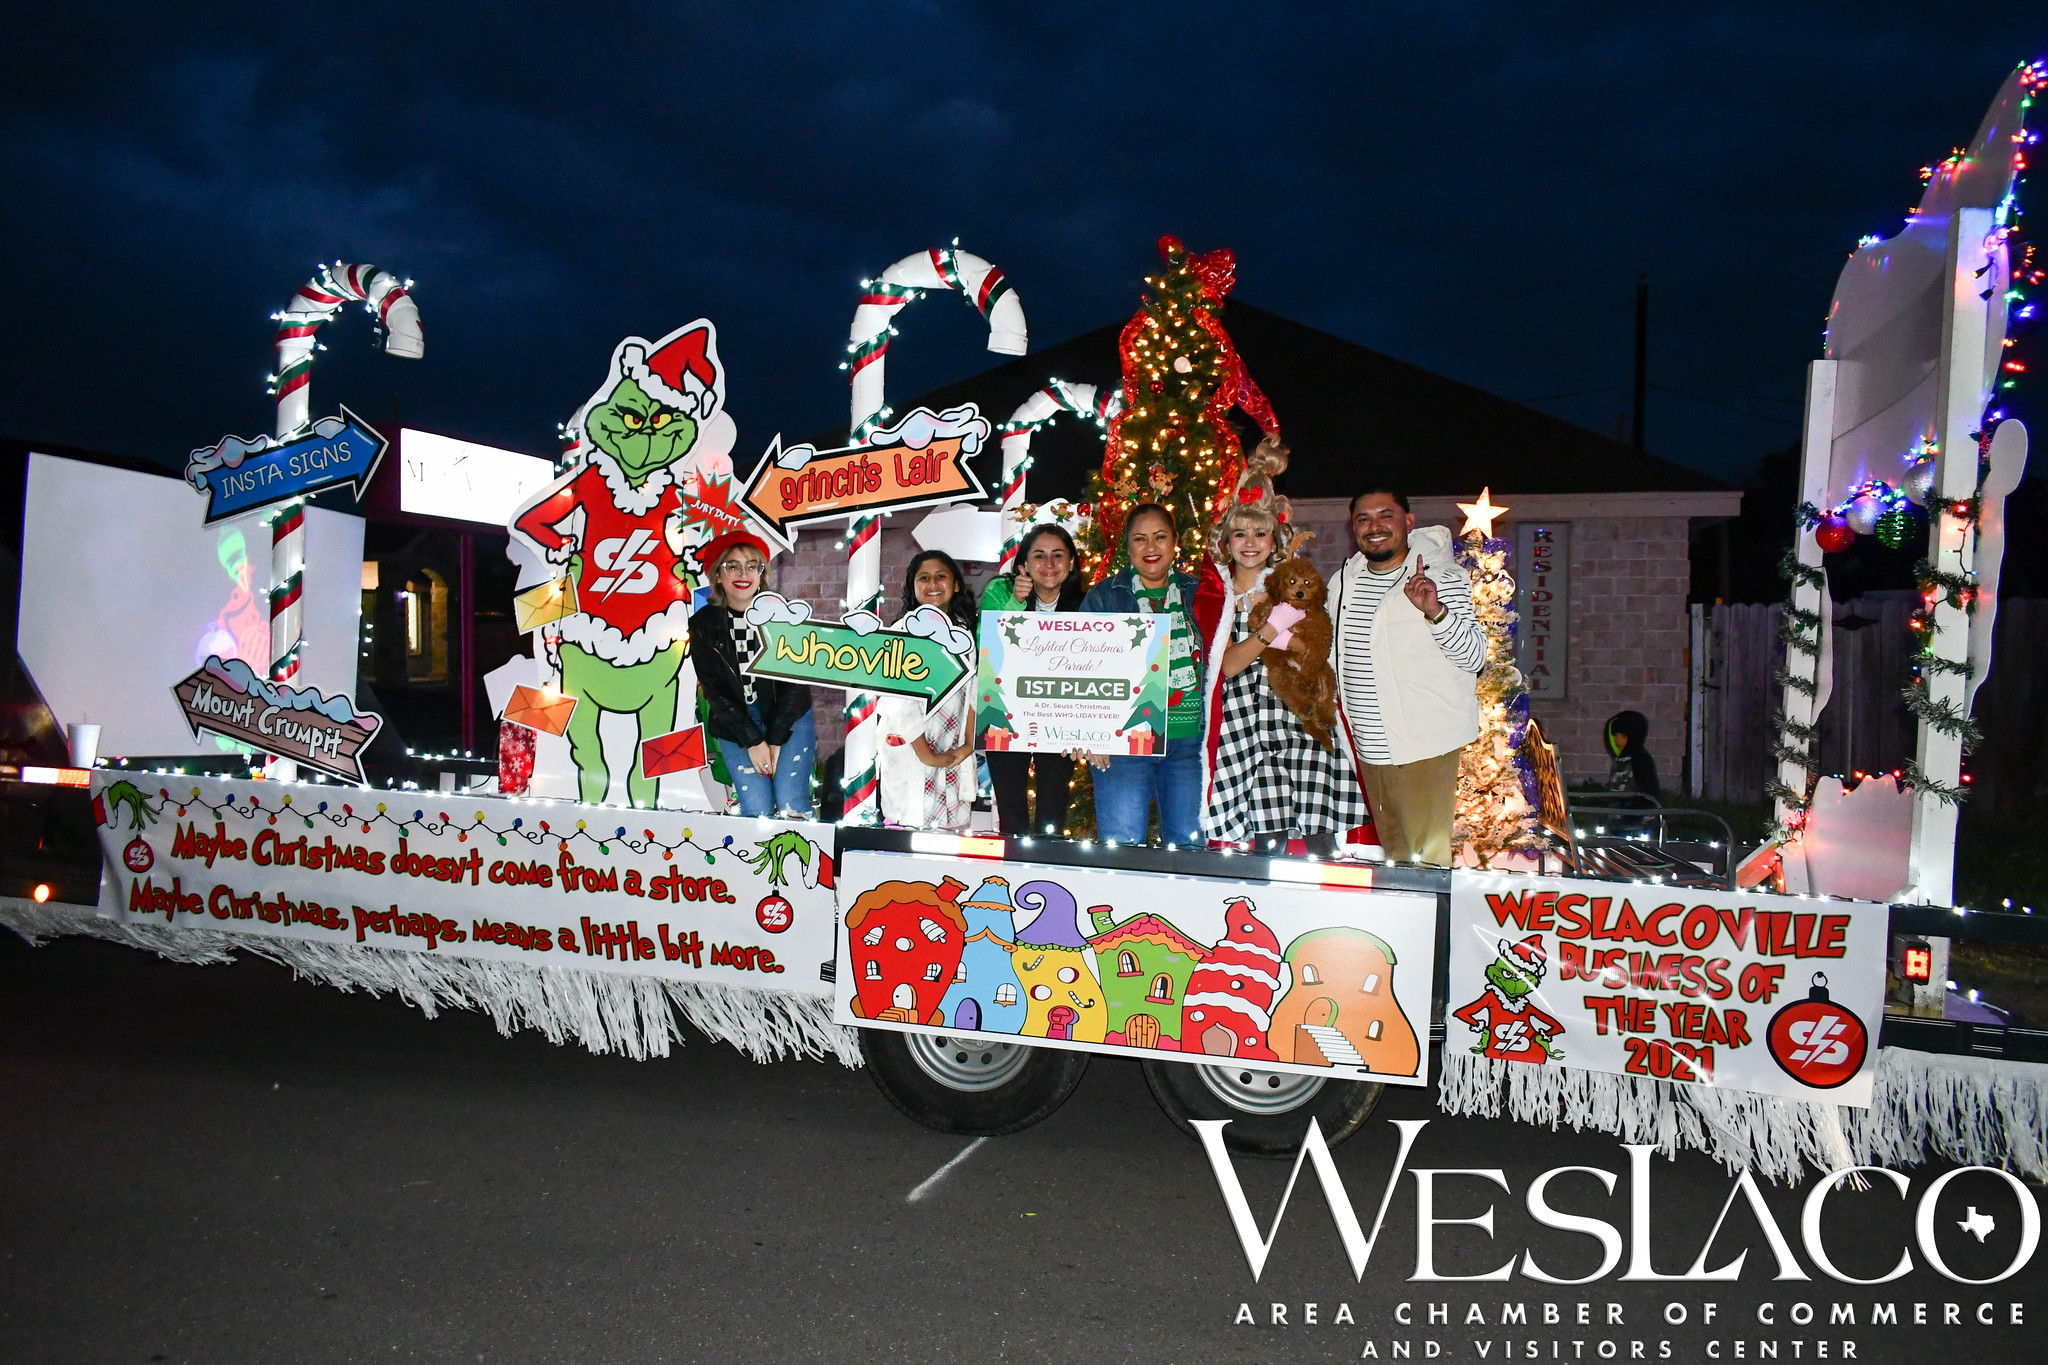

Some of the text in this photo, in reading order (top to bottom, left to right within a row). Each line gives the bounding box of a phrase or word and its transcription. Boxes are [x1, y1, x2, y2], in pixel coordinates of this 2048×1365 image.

[222, 441, 352, 499] INSTA SIGNS
[780, 454, 882, 511] grinch's
[690, 499, 741, 527] JURY DUTY
[1038, 620, 1115, 632] WESLACO
[1530, 531, 1554, 691] RESIDENTIAL
[1021, 635, 1124, 657] Lighted Christmas
[1048, 656, 1102, 671] Parade!
[1024, 680, 1125, 697] 1ST PLACE
[190, 682, 343, 759] Mount Crumpit
[170, 821, 248, 868] Maybe
[251, 828, 386, 876] Christmas
[488, 860, 552, 888] come
[557, 850, 620, 893] from
[623, 869, 646, 897] a
[648, 864, 736, 904] store.
[129, 877, 203, 922] Maybe
[352, 904, 466, 950] perhaps,
[558, 928, 580, 953] a
[580, 916, 656, 961] little
[657, 924, 703, 968] bit
[1484, 889, 1852, 959] WESLACOVILLE
[1559, 941, 1785, 1004] BUSINESS OF
[1583, 996, 1753, 1050] THE YEAR
[1624, 1038, 1716, 1083] 2021
